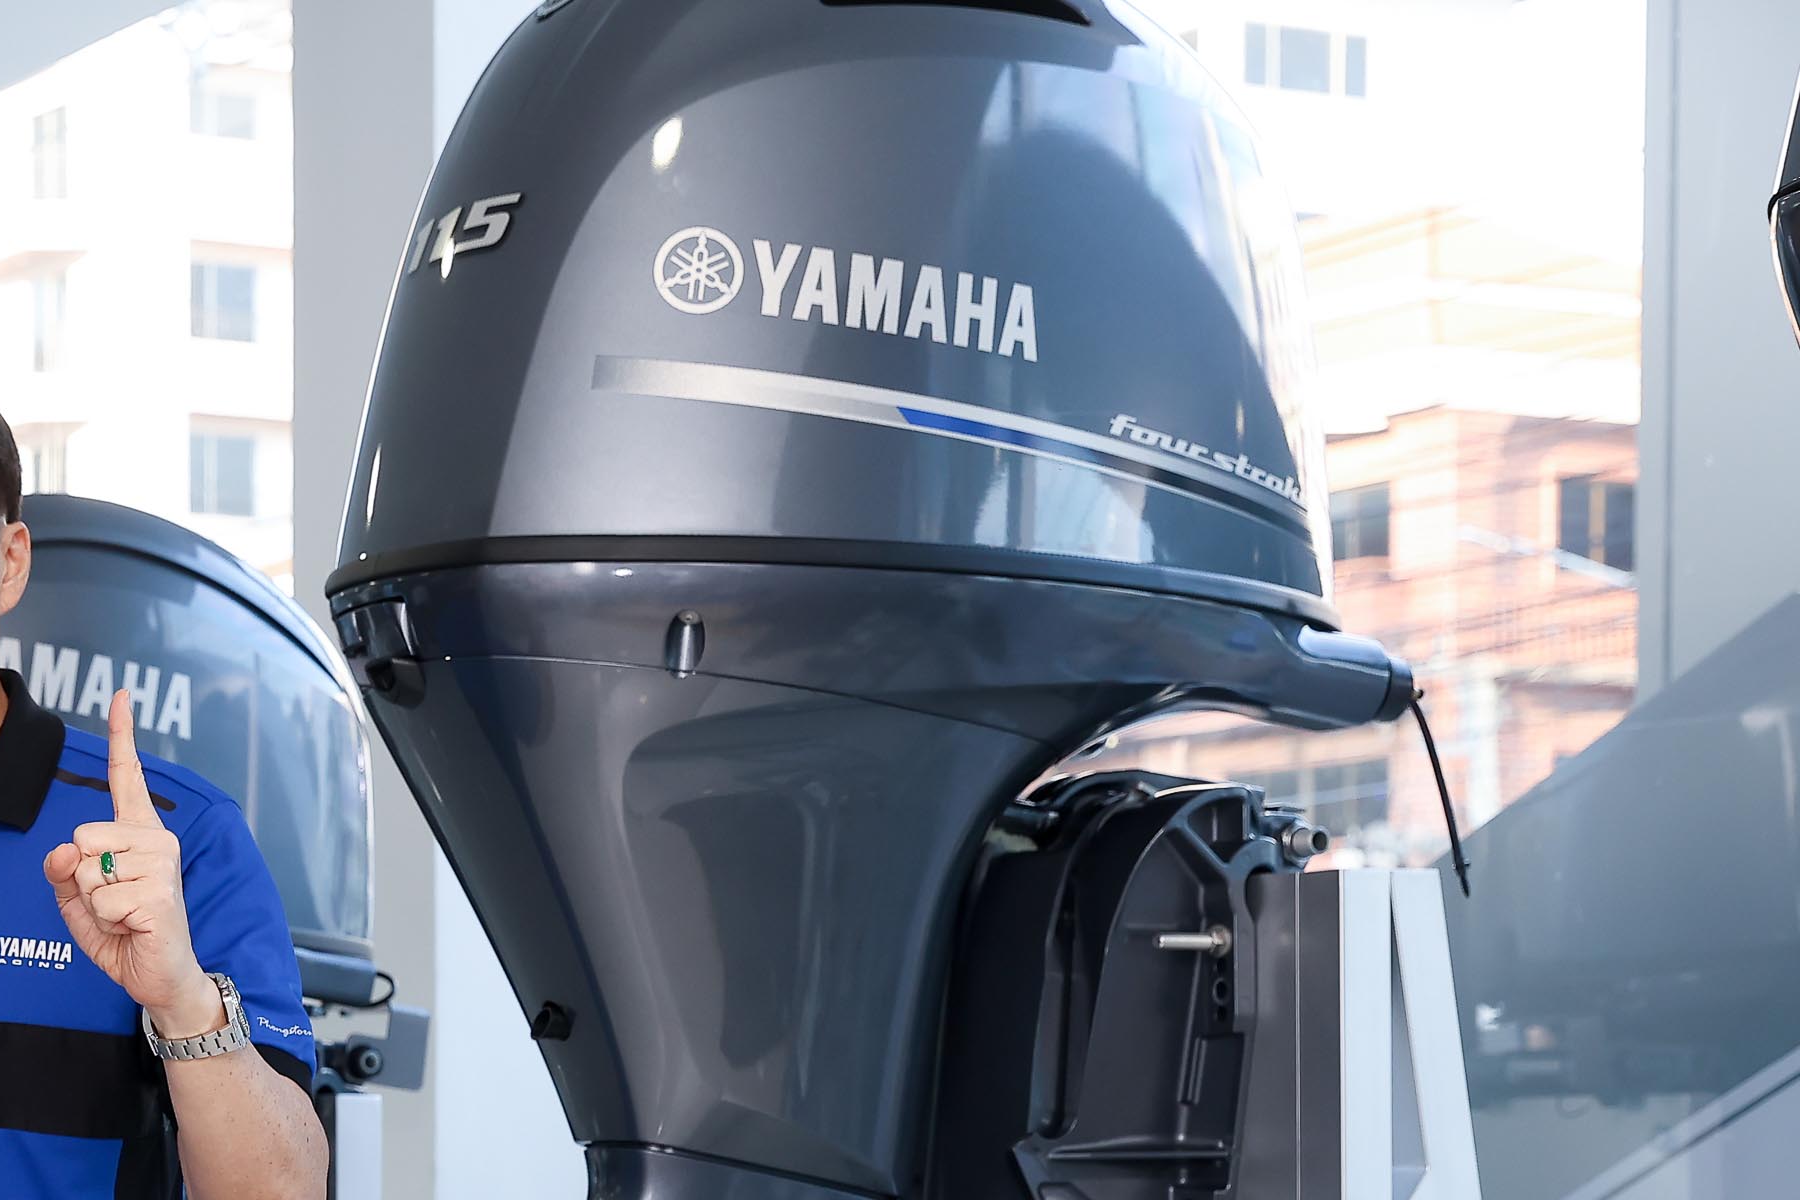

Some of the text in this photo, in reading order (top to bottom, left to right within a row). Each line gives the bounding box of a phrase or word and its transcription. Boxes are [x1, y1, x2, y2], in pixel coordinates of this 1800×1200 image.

[752, 238, 1038, 363] YAMAHA
[1109, 413, 1302, 502] four strok
[0, 936, 72, 963] YAMAHA
